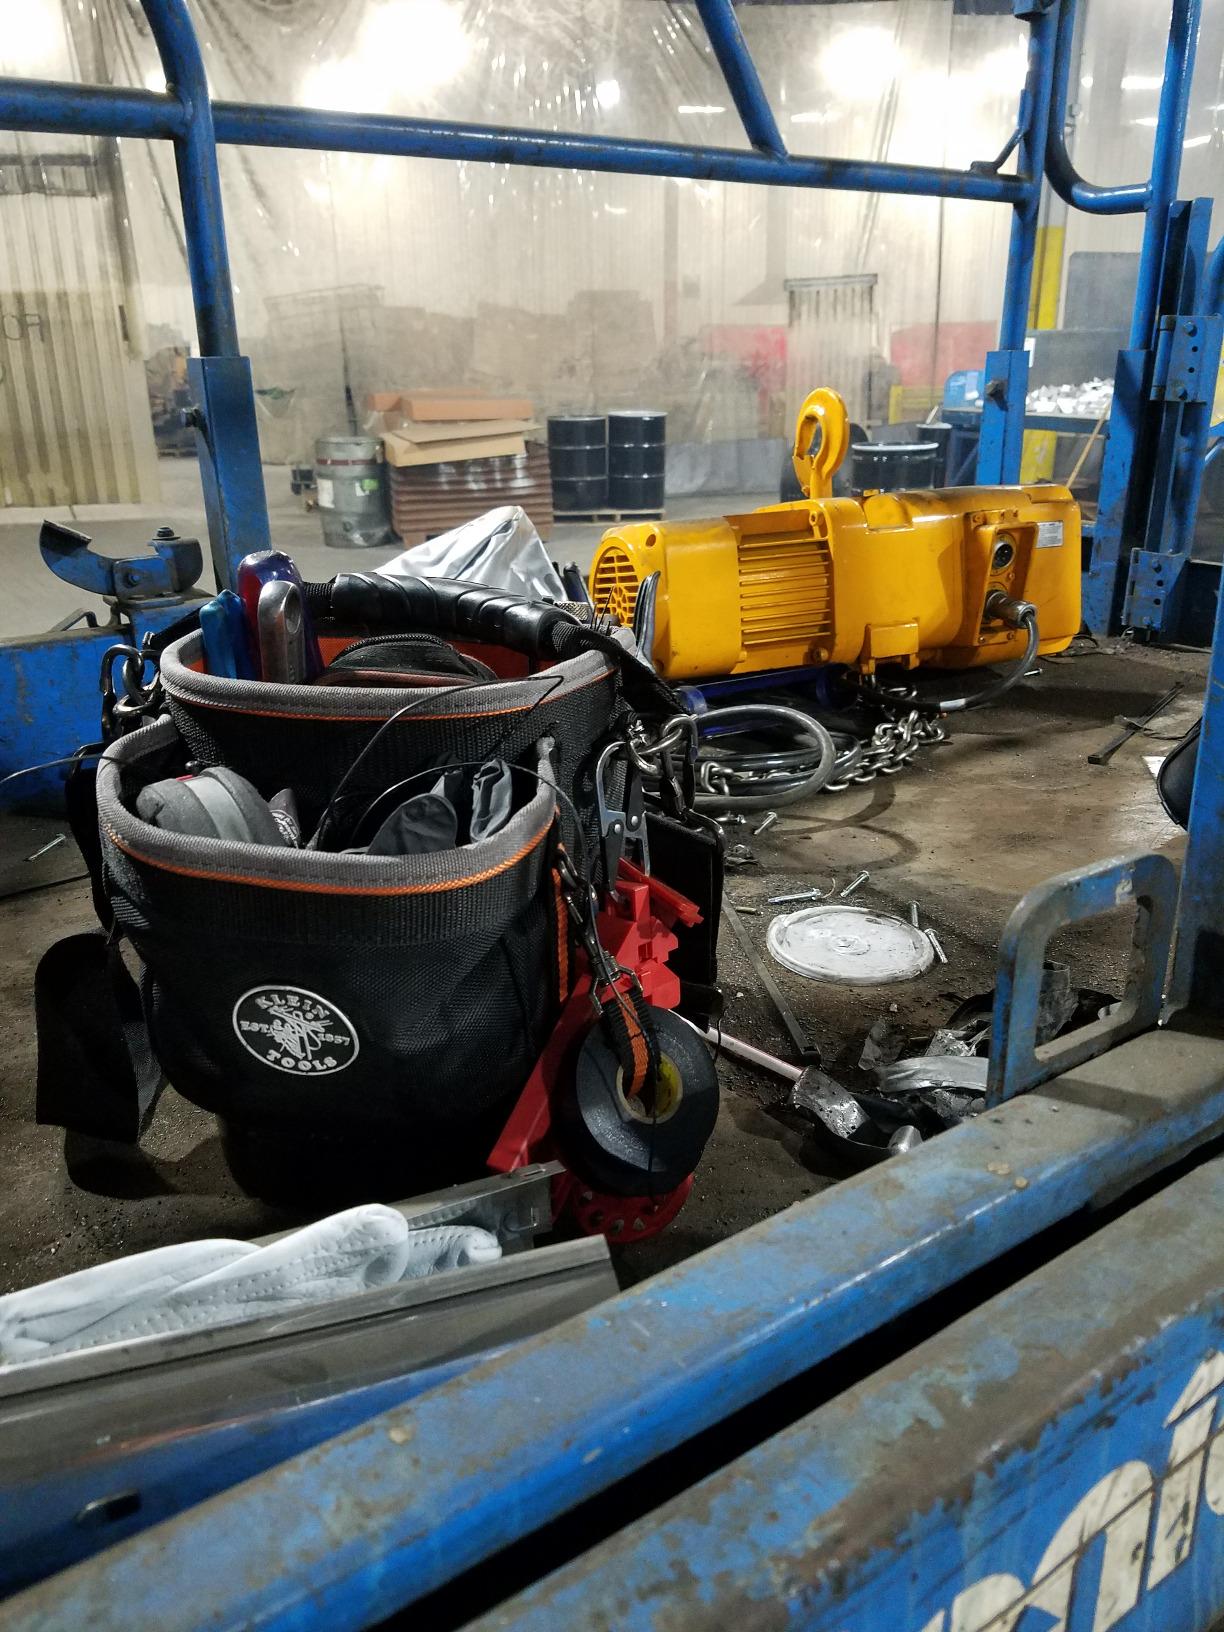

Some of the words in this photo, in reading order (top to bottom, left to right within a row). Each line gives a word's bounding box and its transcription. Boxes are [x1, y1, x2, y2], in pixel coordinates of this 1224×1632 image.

[255, 994, 330, 1019] KLEIN
[317, 1033, 351, 1046] 1857
[266, 1050, 337, 1071] TOOLS
